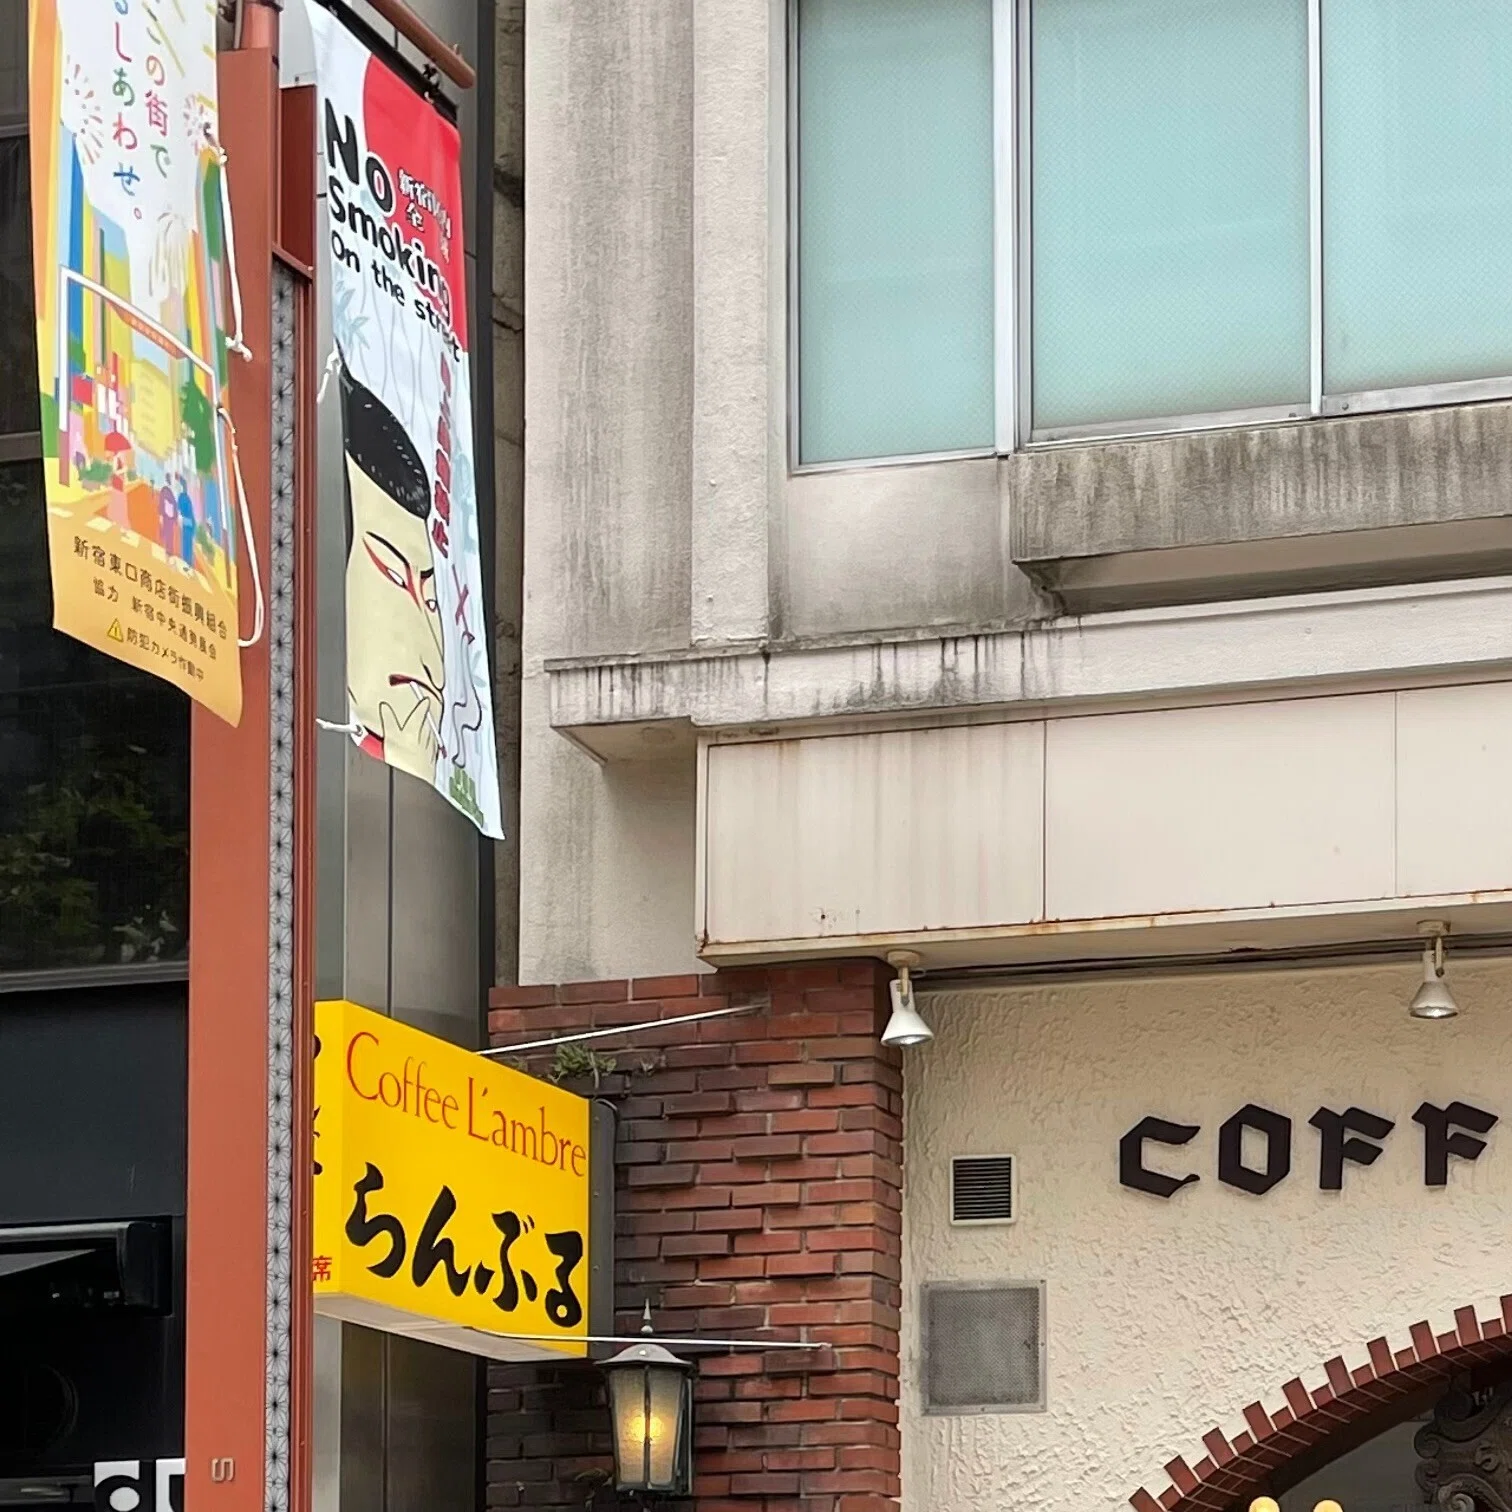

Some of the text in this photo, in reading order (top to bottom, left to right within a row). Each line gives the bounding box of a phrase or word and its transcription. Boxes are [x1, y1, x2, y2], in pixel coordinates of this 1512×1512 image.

[324, 97, 394, 213] NO
[329, 175, 450, 327] Smoking
[331, 230, 460, 363] On the strt
[346, 1031, 459, 1129] Coffee
[467, 1077, 587, 1177] L'ambre
[345, 1161, 584, 1328] らんぶる
